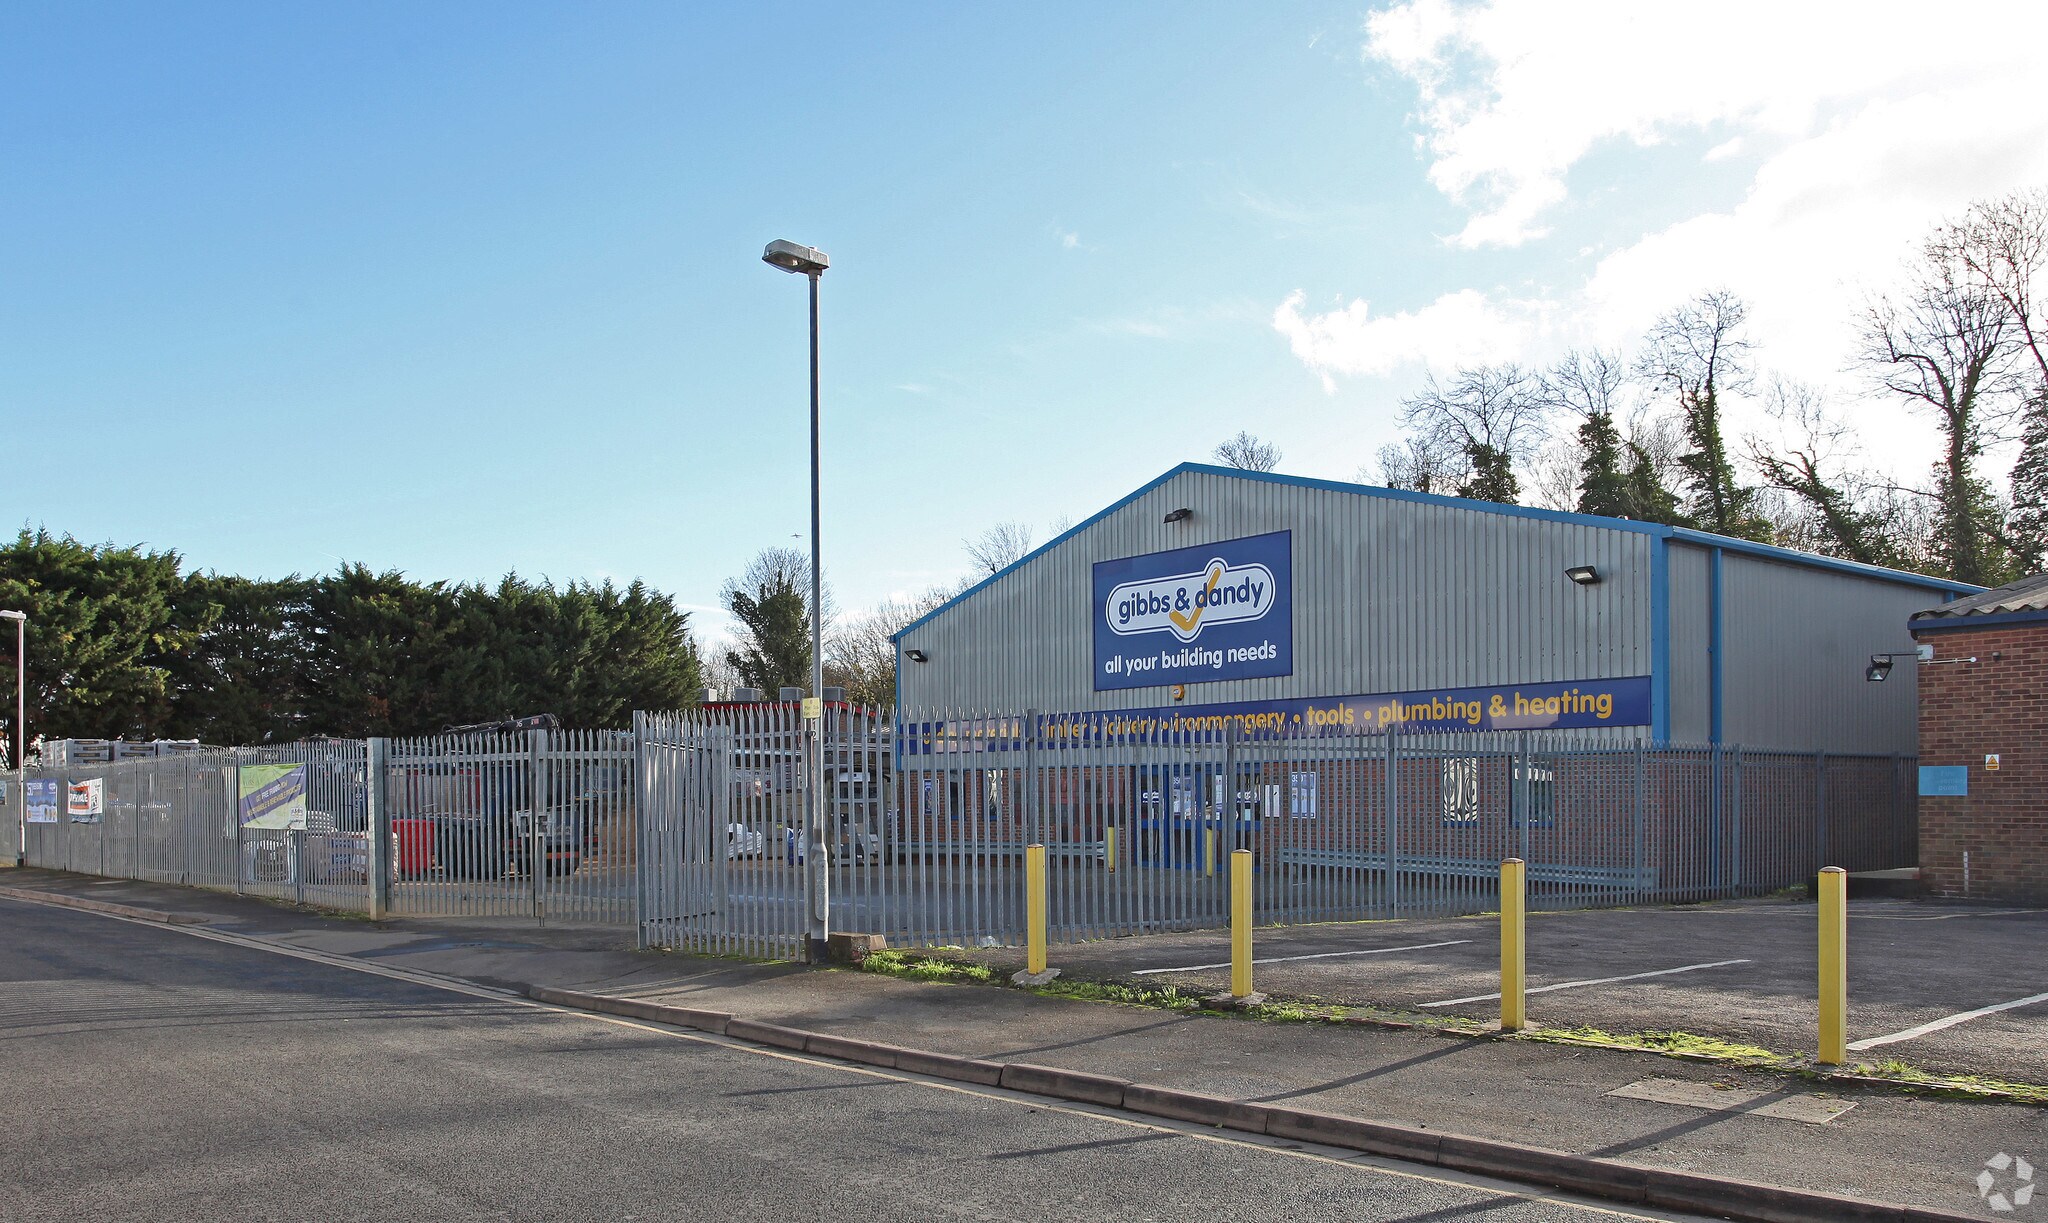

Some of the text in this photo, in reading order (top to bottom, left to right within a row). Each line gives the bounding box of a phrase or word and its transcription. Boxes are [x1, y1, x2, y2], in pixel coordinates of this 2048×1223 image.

[1118, 576, 1264, 625] gibbs & dandy
[1104, 639, 1277, 677] all your building needs
[1103, 715, 1156, 741] oinery
[1306, 702, 1354, 726] tools
[1378, 696, 1482, 728] plumbing
[1488, 693, 1507, 717] &
[1513, 688, 1613, 719] heating
